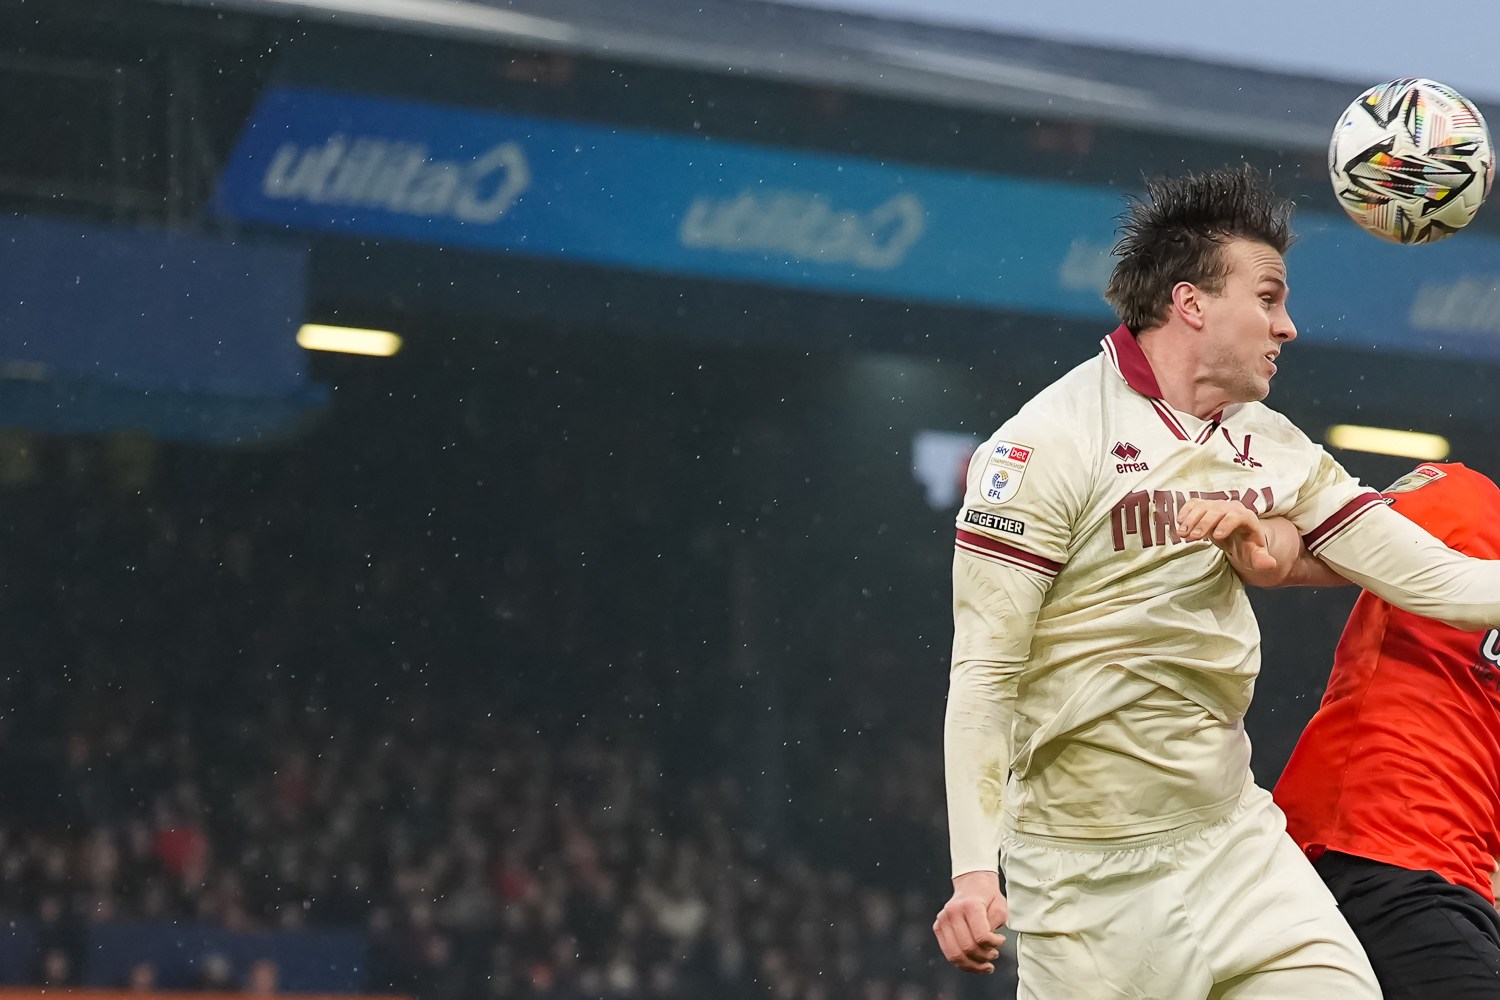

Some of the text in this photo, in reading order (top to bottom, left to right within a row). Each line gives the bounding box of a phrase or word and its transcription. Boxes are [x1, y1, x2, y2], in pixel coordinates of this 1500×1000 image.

[263, 131, 458, 214] utilita
[680, 189, 860, 264] utilita
[995, 445, 1028, 460] sky bet
[987, 489, 1001, 500] EFL
